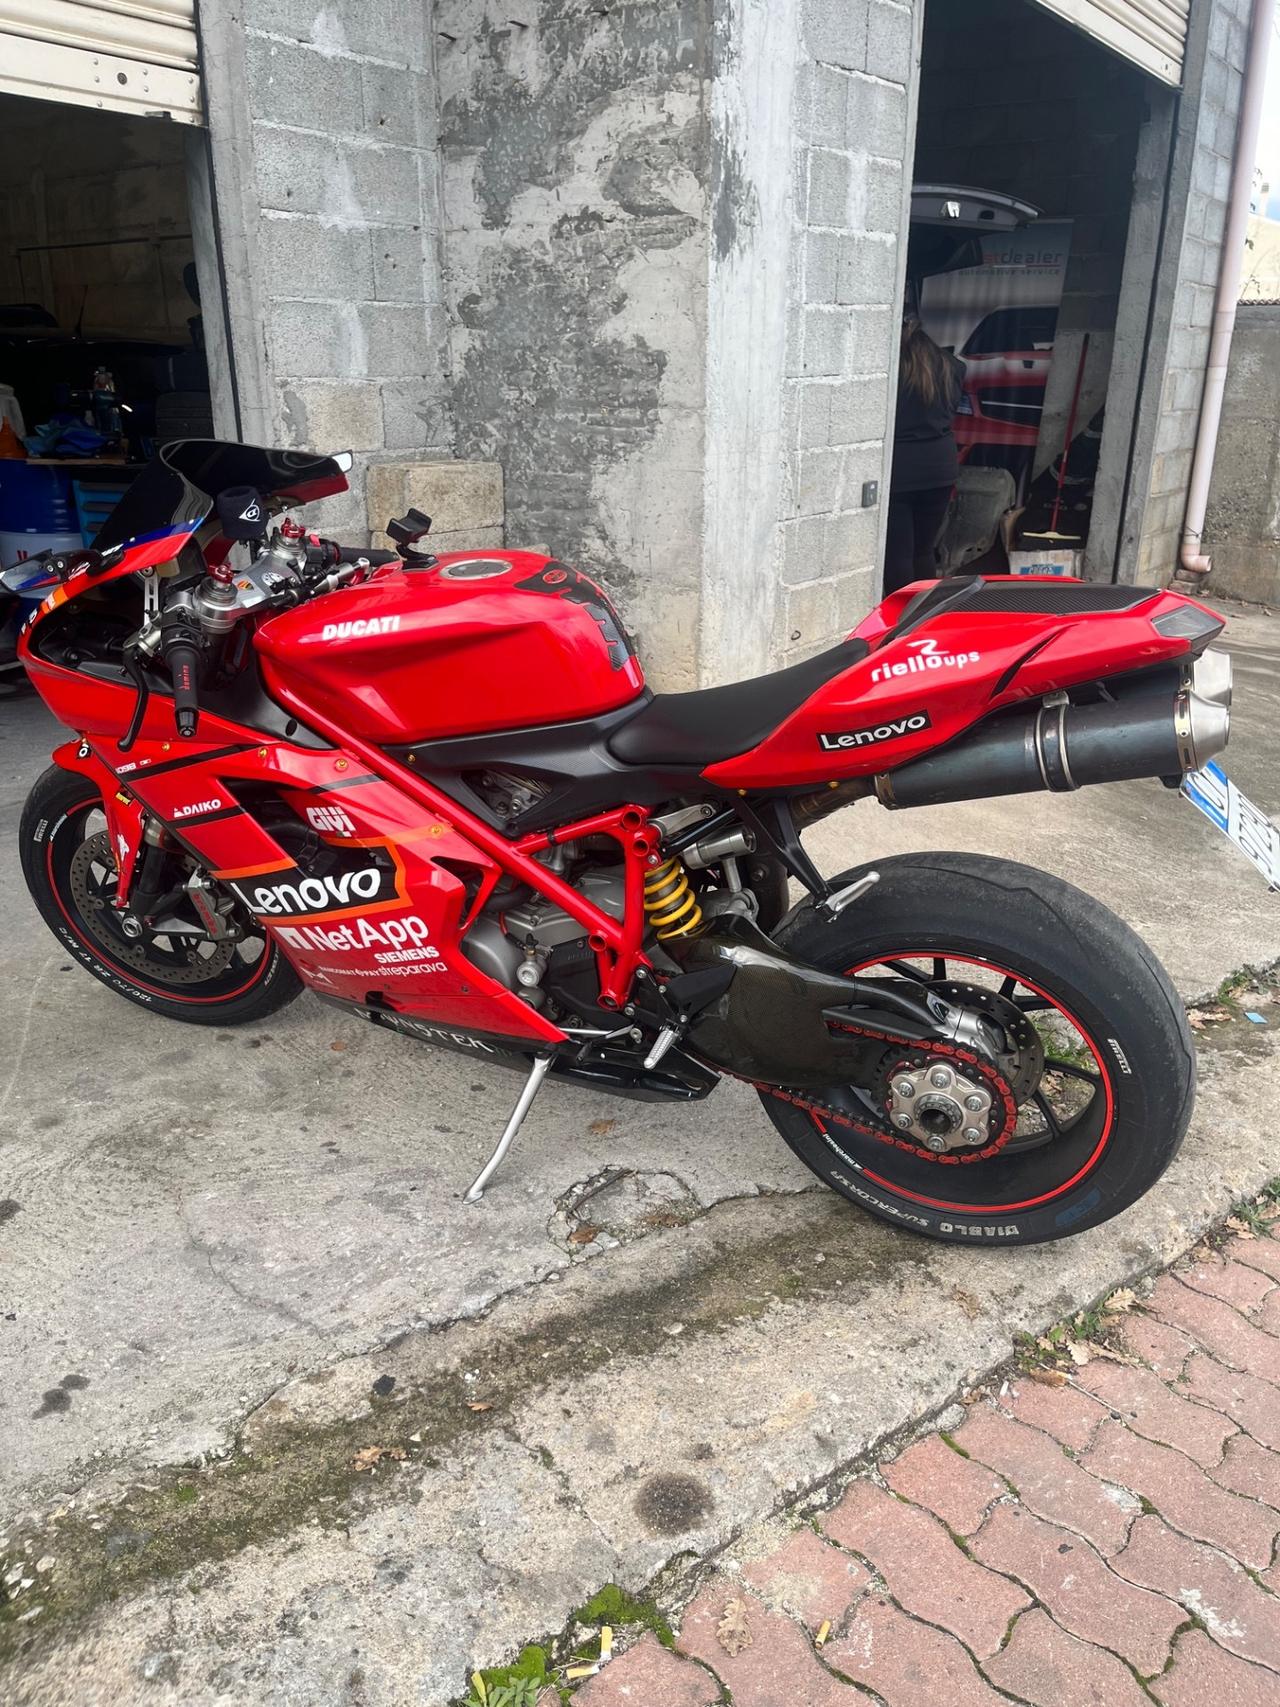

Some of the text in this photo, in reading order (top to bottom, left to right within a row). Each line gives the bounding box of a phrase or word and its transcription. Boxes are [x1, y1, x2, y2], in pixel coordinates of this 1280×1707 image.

[322, 615, 400, 640] DUCATI
[820, 715, 926, 749] Lenovo
[182, 798, 222, 816] DAIKO
[33, 818, 48, 842] PIRELLI
[306, 806, 356, 837] GIVI
[230, 868, 381, 914] Lenovo
[302, 915, 429, 950] NetApp
[374, 946, 440, 964] SIEMENS
[93, 964, 111, 977] ZR
[378, 962, 448, 977] streparava
[113, 979, 152, 1002] 120/70
[1107, 1038, 1132, 1074] PIRELLI
[823, 1134, 856, 1167] marchesini
[939, 1222, 1019, 1237] DIABLO
